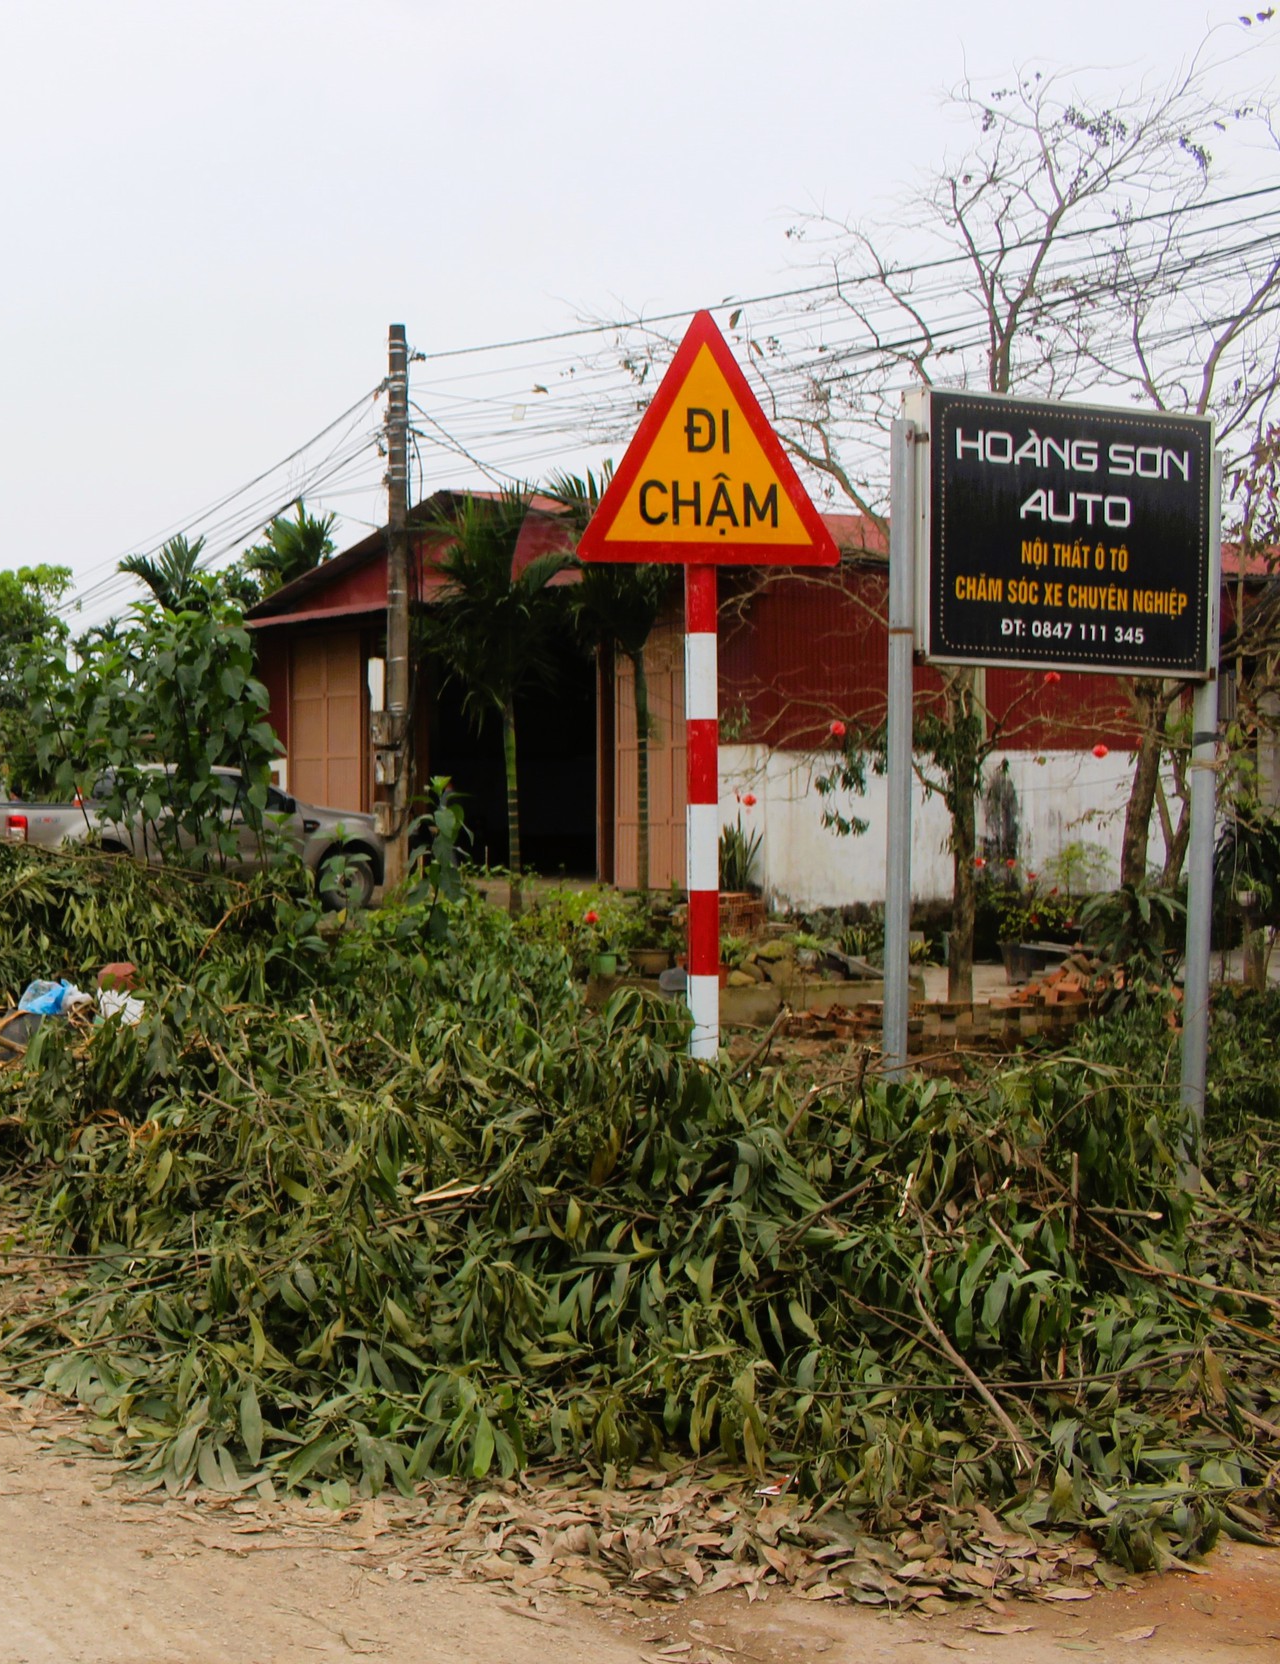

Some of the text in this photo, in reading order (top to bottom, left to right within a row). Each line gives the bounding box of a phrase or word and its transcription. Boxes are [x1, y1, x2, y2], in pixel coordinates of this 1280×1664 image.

[684, 408, 730, 453] ĐI
[956, 428, 1189, 482] HOÀNG SƠN
[639, 473, 779, 536] CHẬM
[1020, 489, 1131, 528] AUTO
[1021, 537, 1128, 572] NỘI THẤT Ô TÔ
[955, 573, 1188, 620] CHĂM SÓC XE CHUYÊN NGHIỆP
[1001, 618, 1145, 644] ĐT: 0847 111 345
